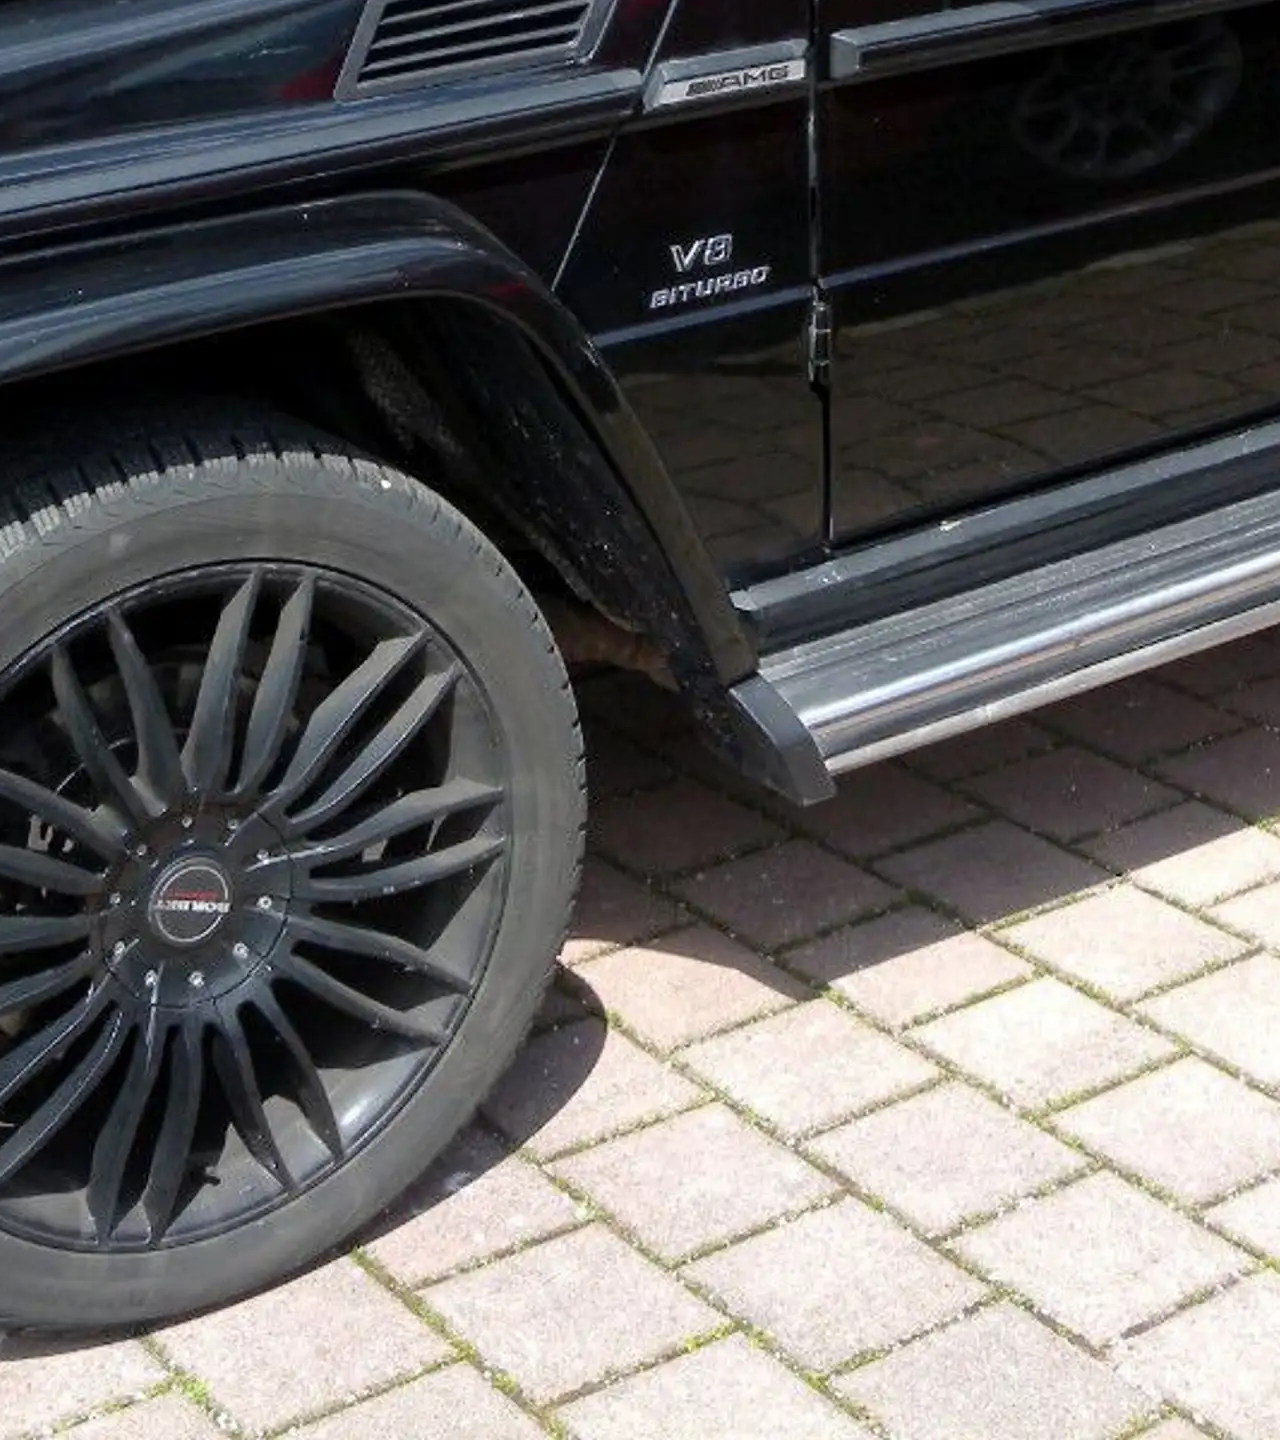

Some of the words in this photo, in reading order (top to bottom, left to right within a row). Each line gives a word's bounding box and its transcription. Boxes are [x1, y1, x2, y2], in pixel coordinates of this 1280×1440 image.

[720, 64, 790, 87] AMG
[668, 233, 733, 272] V8
[649, 264, 772, 308] BITURBO
